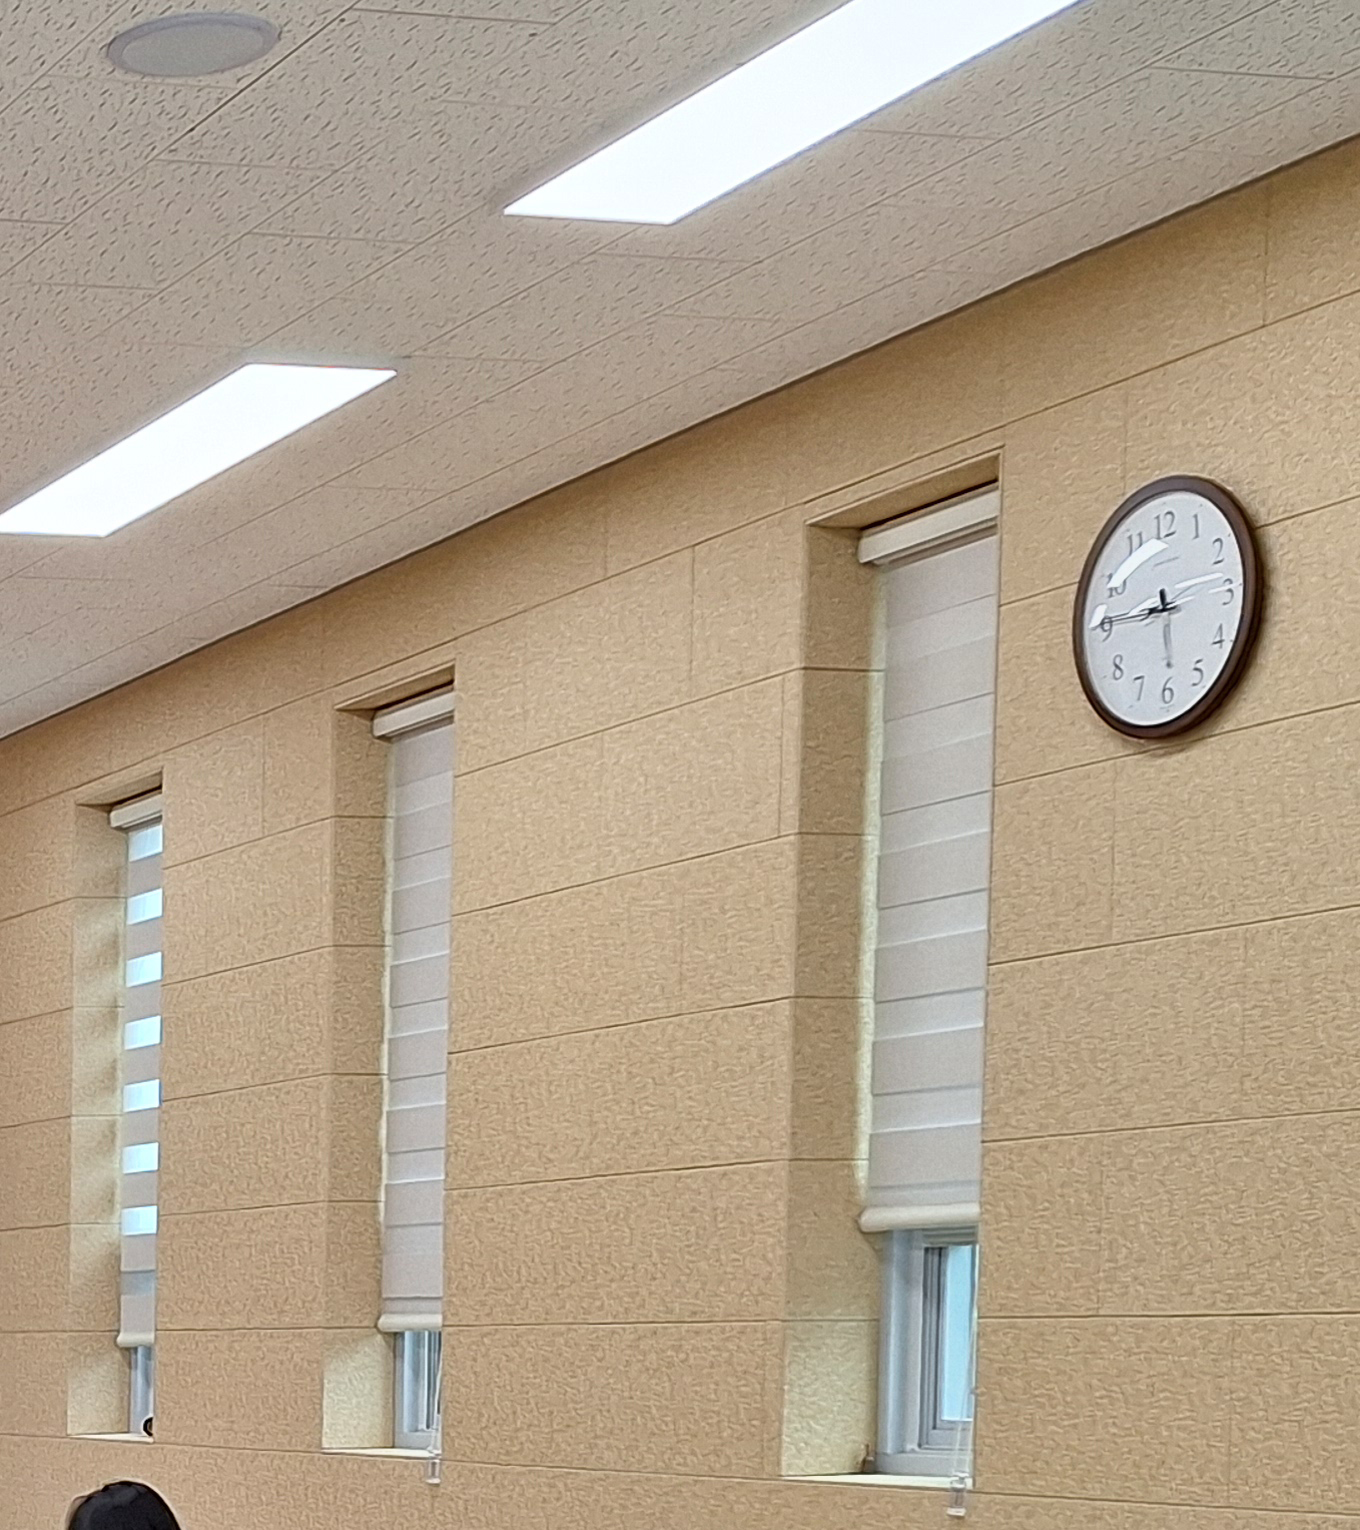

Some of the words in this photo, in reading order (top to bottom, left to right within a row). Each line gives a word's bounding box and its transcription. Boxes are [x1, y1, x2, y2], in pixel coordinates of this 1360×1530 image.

[1154, 511, 1176, 540] 12
[1192, 513, 1200, 540] 1
[1212, 537, 1225, 565] 2
[1222, 578, 1234, 606] 3
[1100, 616, 1113, 642] 9
[1211, 623, 1225, 649] 4
[1112, 654, 1124, 681] 8
[1191, 659, 1204, 687] 5
[1133, 675, 1145, 702] 7
[1162, 676, 1174, 704] 6
